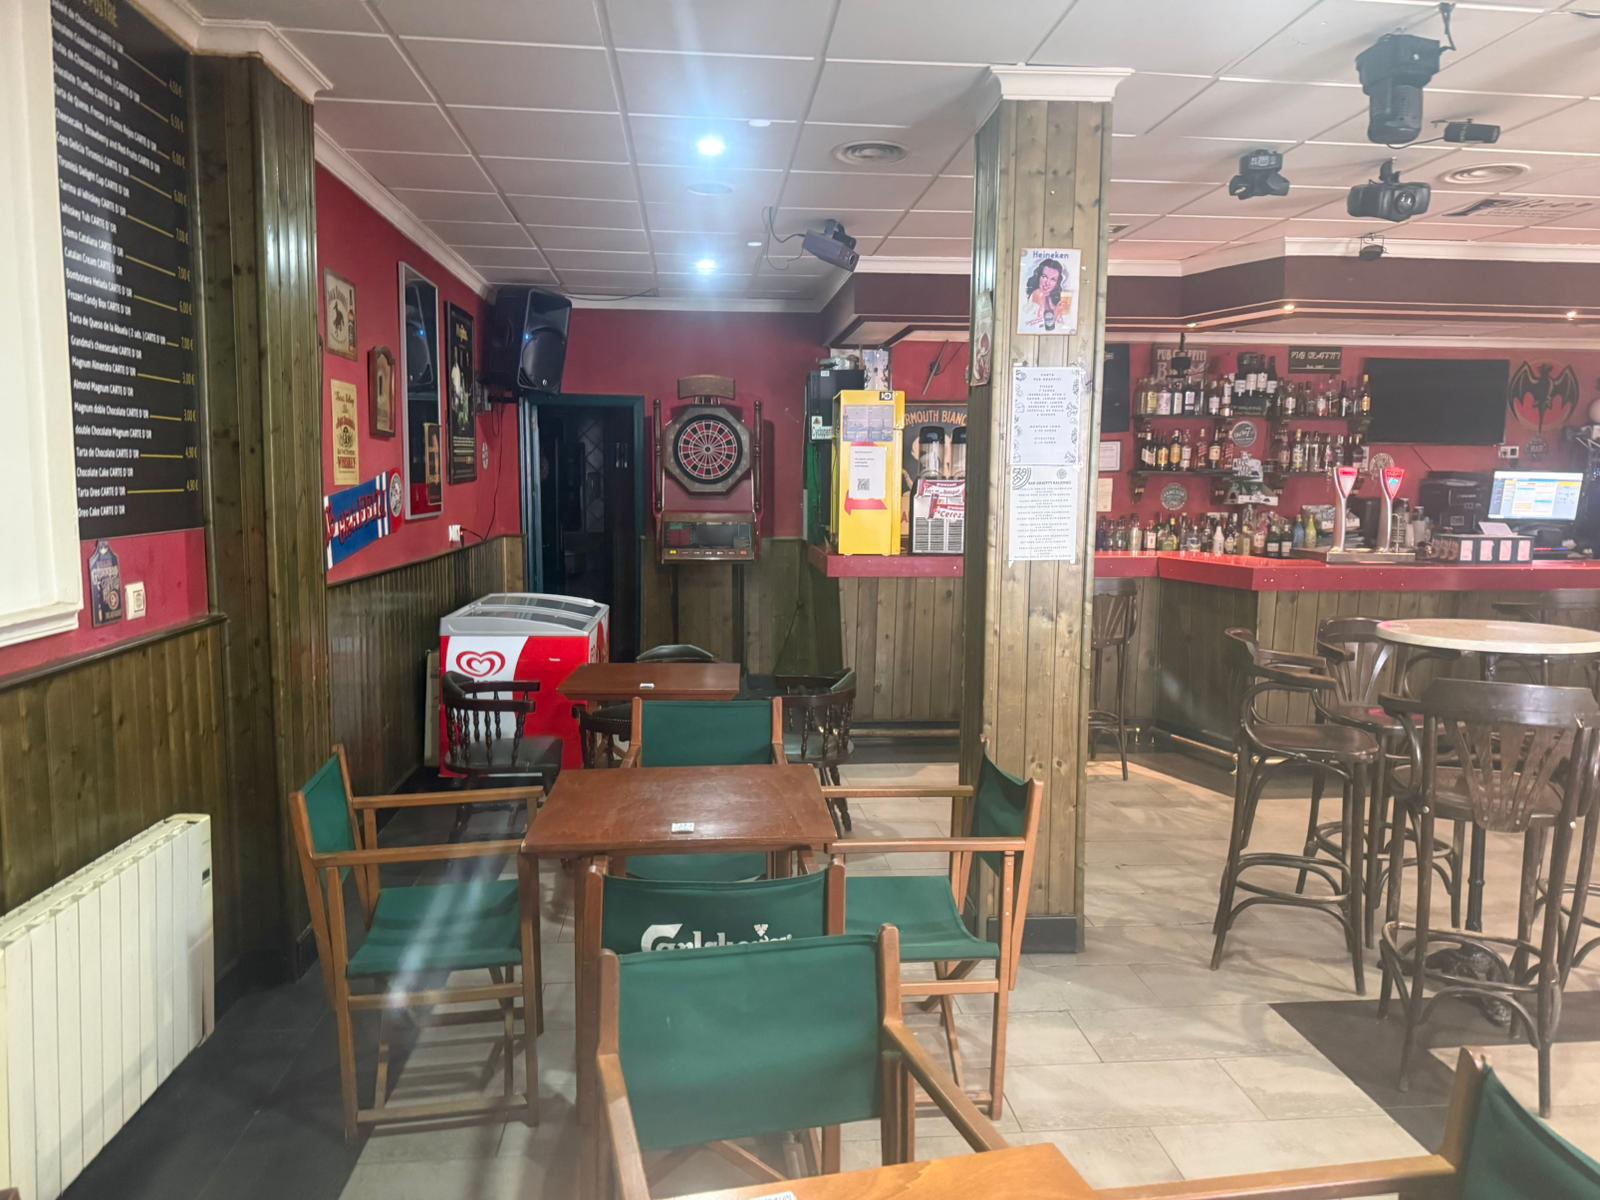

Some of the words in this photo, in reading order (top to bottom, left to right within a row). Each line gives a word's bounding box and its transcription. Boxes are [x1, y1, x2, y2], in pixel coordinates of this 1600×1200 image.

[63, 227, 78, 241] Crema
[79, 232, 98, 248] Catalana
[98, 240, 112, 253] CARTE
[64, 247, 82, 262] Catalan
[83, 254, 97, 268] Cream
[97, 259, 111, 272] CARTE
[1033, 250, 1069, 259] Heineken
[66, 268, 92, 286] Bombonera
[93, 277, 108, 290] Helada
[108, 282, 121, 294] CARTE
[67, 290, 83, 304] Frozen
[84, 295, 98, 309] Candy
[107, 301, 120, 314] CARTE
[70, 312, 82, 325] Tarta
[89, 317, 103, 331] Queso
[114, 324, 128, 336] Abuela
[144, 332, 156, 343] CARTE
[71, 336, 94, 350] Grandma's
[95, 341, 118, 355] cheesecake
[119, 346, 131, 357] CARTE
[72, 356, 91, 371] Magnum
[92, 360, 112, 373] Almendra
[112, 364, 125, 375] CARTE
[73, 380, 91, 392] Almond
[91, 382, 109, 396] Magnum
[110, 385, 123, 396] CARTE
[74, 402, 93, 415] Magnum
[94, 404, 106, 414] doble
[106, 405, 125, 417] Chocolate
[126, 408, 139, 418] CARTE
[75, 425, 91, 435] double
[91, 426, 111, 437] Chocolate
[112, 428, 129, 439] Magnum
[130, 429, 142, 439] CARTE
[76, 447, 88, 457] Tarta
[95, 448, 115, 458] Chocolate
[116, 449, 128, 458] CARTE
[77, 468, 98, 477] Chocolate
[99, 468, 109, 477] Cake
[110, 468, 122, 477] CARTE
[78, 488, 89, 498] Tarta
[90, 488, 100, 497] Oreo
[101, 487, 114, 497] CARTE
[89, 507, 100, 517] Cake
[100, 506, 114, 516] CARTE
